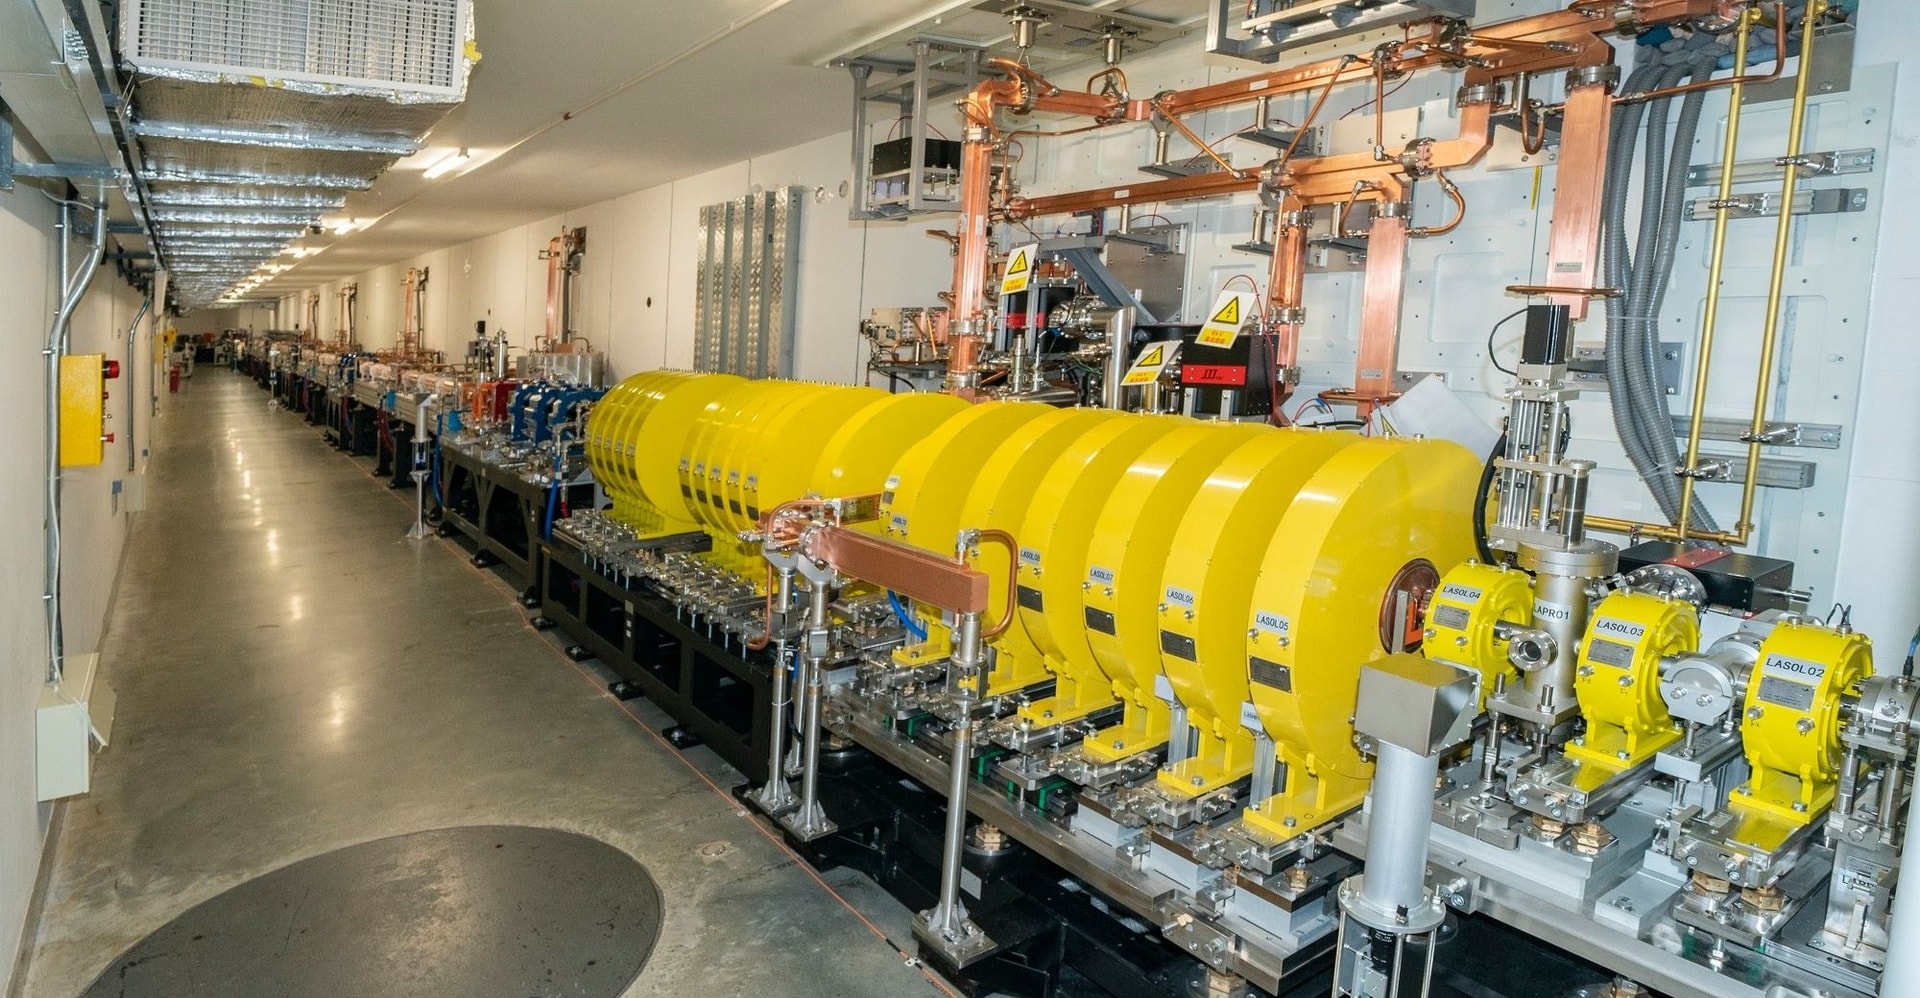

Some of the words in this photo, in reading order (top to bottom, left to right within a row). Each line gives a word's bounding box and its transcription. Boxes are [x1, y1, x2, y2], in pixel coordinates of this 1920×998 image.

[1090, 568, 1114, 581] LASOL07
[1166, 589, 1194, 604] LASOL06
[1442, 585, 1481, 599] LASOL04
[1256, 614, 1289, 631] LASOL05
[1596, 619, 1645, 637] LASOL03
[1766, 657, 1825, 678] LASOL02
